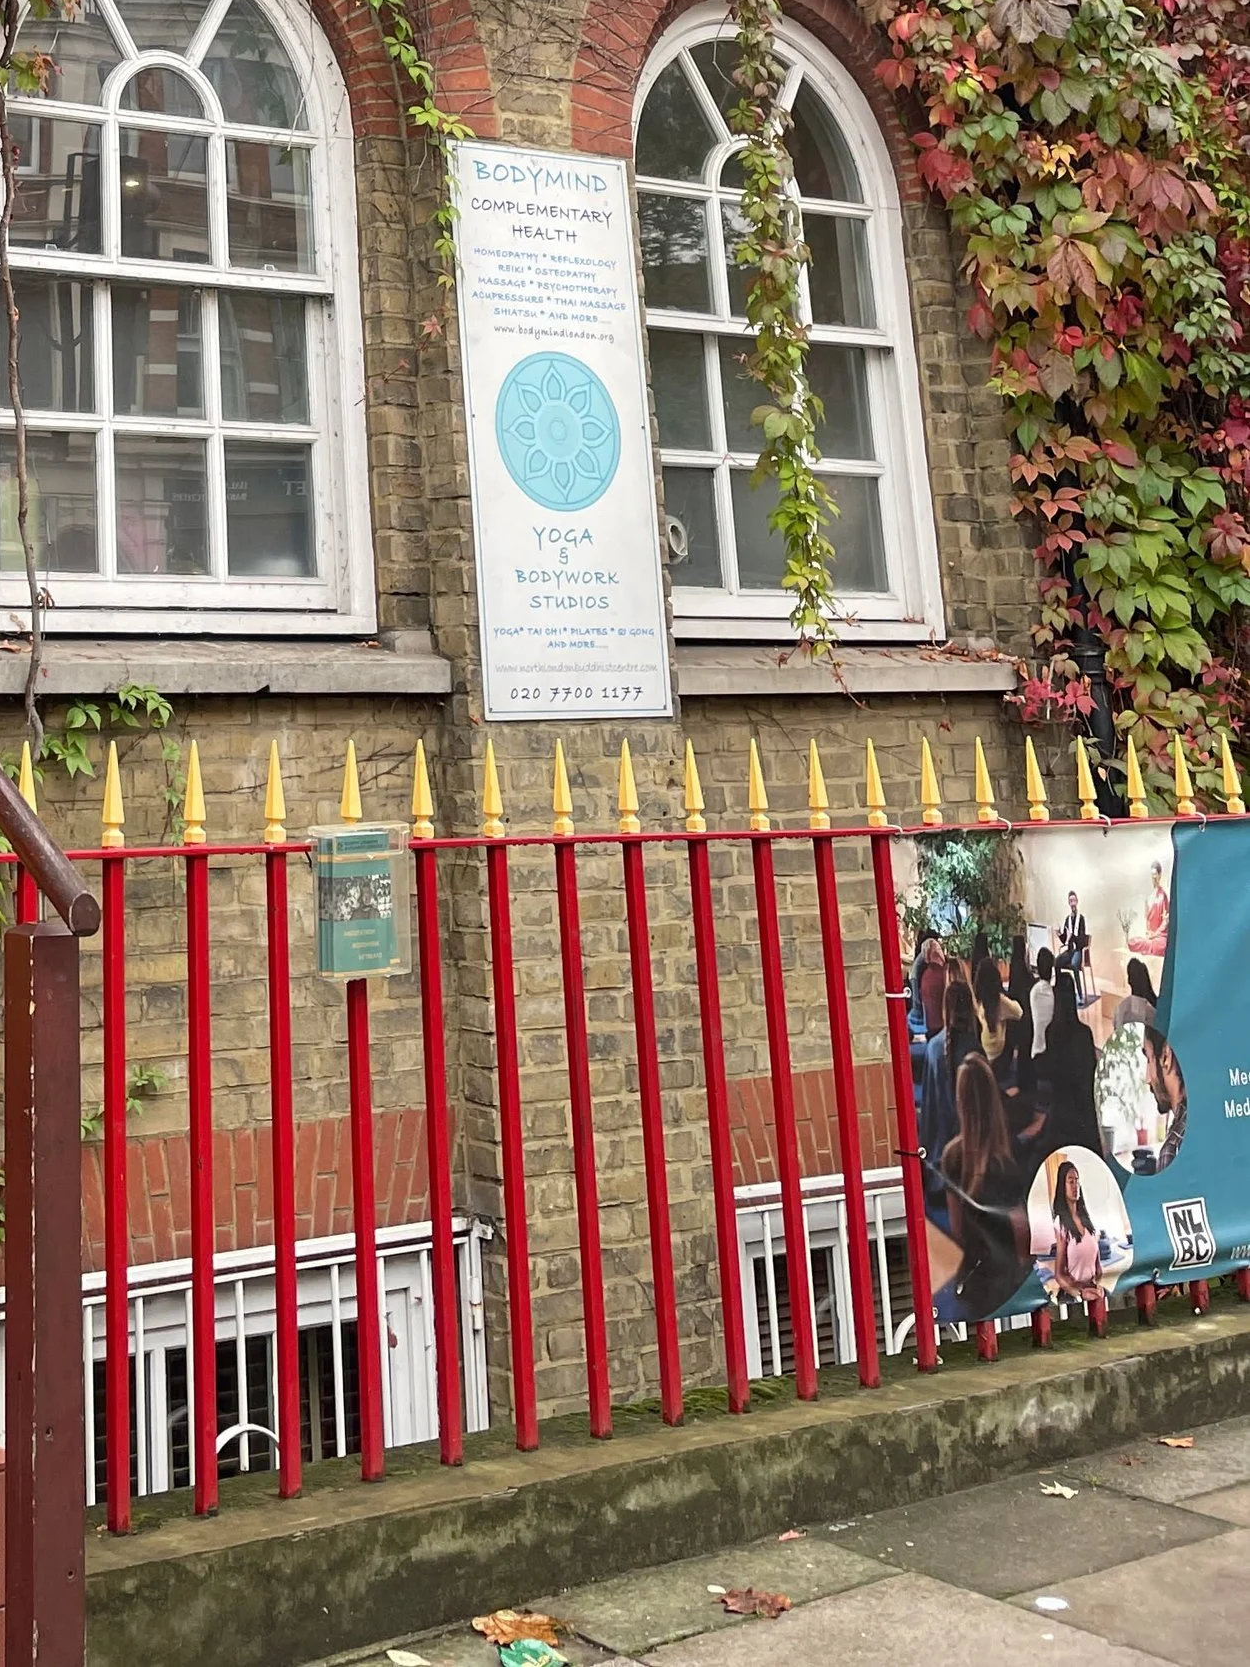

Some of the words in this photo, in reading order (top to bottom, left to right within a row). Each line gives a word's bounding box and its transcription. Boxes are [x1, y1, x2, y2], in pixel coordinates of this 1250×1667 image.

[473, 160, 608, 194] BODYMIND
[471, 197, 613, 230] COMPLEMENTARY
[512, 225, 578, 244] HEALTH
[473, 247, 539, 263] HOMEOPATHY
[550, 254, 617, 270] REFLEXOLOGY
[498, 264, 525, 274] REIKI
[535, 267, 597, 282] OSTEOPATHY
[478, 277, 527, 289] MASSAGE
[537, 281, 618, 298] PSYCHOTHERAPY
[471, 291, 545, 305] ACUPRESSURE
[554, 297, 577, 307] THAI
[580, 300, 627, 312] MASSAGE
[493, 307, 538, 319] SHIATSU
[548, 311, 569, 322] AND
[494, 324, 615, 344] www.bodymindlondon.org
[533, 525, 594, 551] YOGA
[559, 546, 569, 565] &
[515, 568, 619, 590] BODYWORK
[529, 595, 610, 610] STUDIOS
[493, 627, 521, 638] YOGA
[527, 627, 542, 636] TAI
[570, 627, 608, 636] PILATES
[629, 627, 655, 637] GONG
[547, 641, 567, 649] AND
[510, 687, 541, 700] 020
[549, 687, 594, 702] 7700
[602, 686, 644, 702] 1177
[1229, 1067, 1250, 1087] Me
